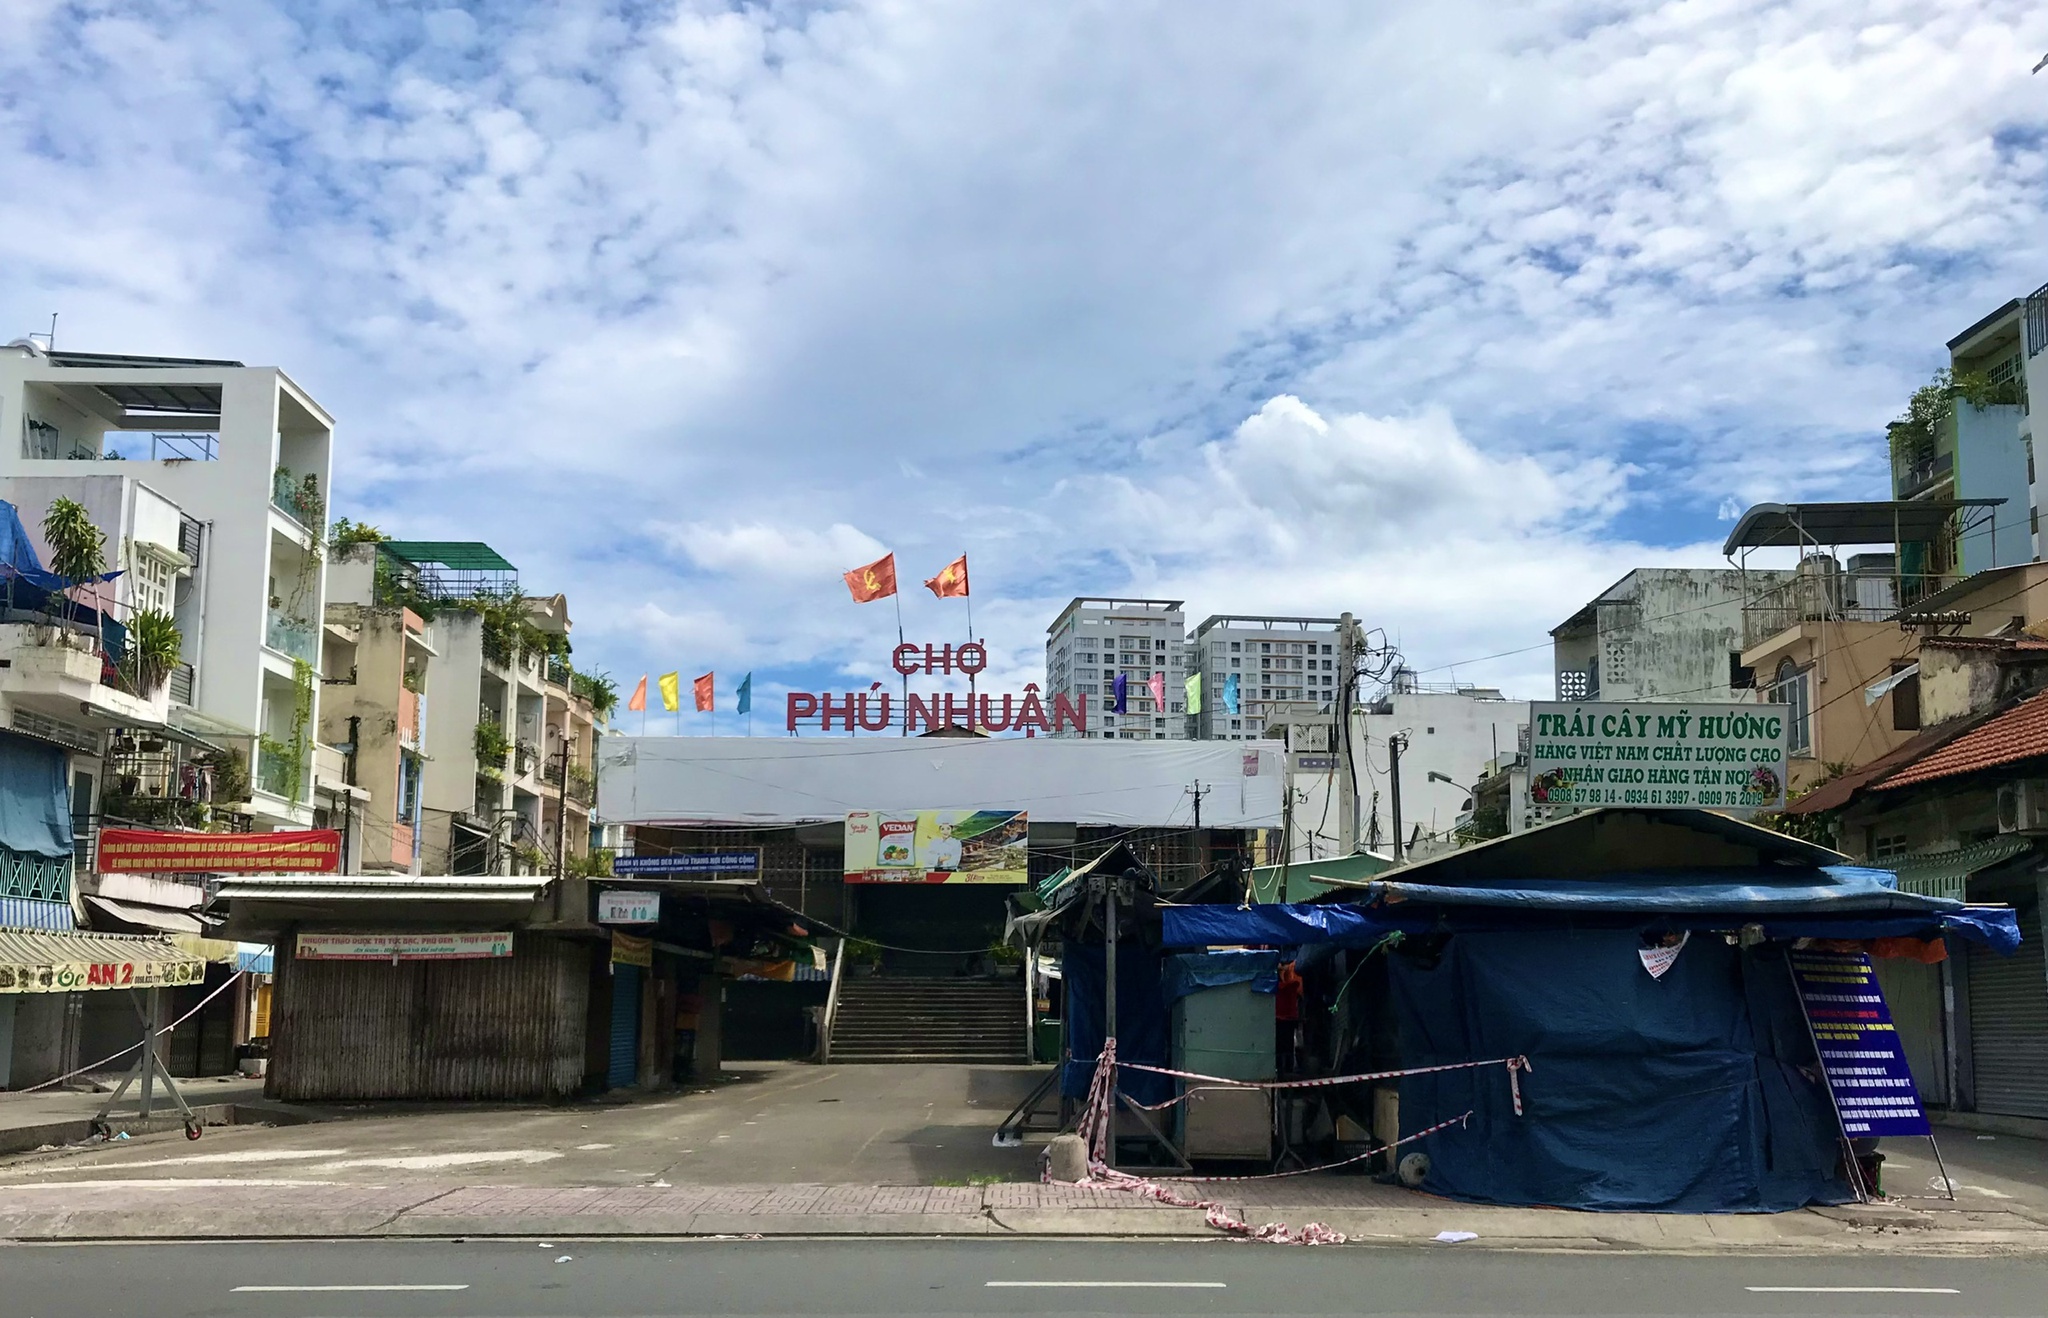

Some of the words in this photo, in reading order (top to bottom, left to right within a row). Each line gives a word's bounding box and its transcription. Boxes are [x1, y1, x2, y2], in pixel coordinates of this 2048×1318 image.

[893, 638, 986, 681] CHỢ
[787, 682, 890, 731] PHÚ
[908, 683, 1086, 738] NHUẬN
[1536, 708, 1596, 737] TRÁI
[1601, 708, 1652, 738] CÂY
[1656, 709, 1692, 738] MỸ
[1698, 711, 1782, 739] HƯƠNG
[1534, 740, 1577, 759] HÀNG
[1580, 741, 1613, 763] VIỆT
[1616, 746, 1649, 761] NAM
[1653, 740, 1692, 761] CHẤT
[1696, 746, 1747, 765] LƯỢNG
[1750, 748, 1781, 762] CAO
[1562, 764, 1604, 786] NHẬN
[1608, 768, 1644, 783] GIAO
[1647, 765, 1690, 784] HÀNG
[1693, 766, 1722, 788] TẬN
[1725, 769, 1751, 785] NƠI
[1548, 788, 1572, 802] 0908
[1574, 789, 1587, 802] 57
[1589, 789, 1601, 802] 98
[1604, 789, 1616, 803] 14
[1624, 789, 1648, 803] 0934
[1651, 790, 1662, 803] 61
[1665, 790, 1690, 804] 3997
[1698, 791, 1722, 805] 0909
[1725, 791, 1737, 805] 76
[1739, 791, 1764, 806] 2019
[882, 823, 914, 832] VEDAN
[87, 963, 118, 985] AN
[121, 962, 134, 984] 2
